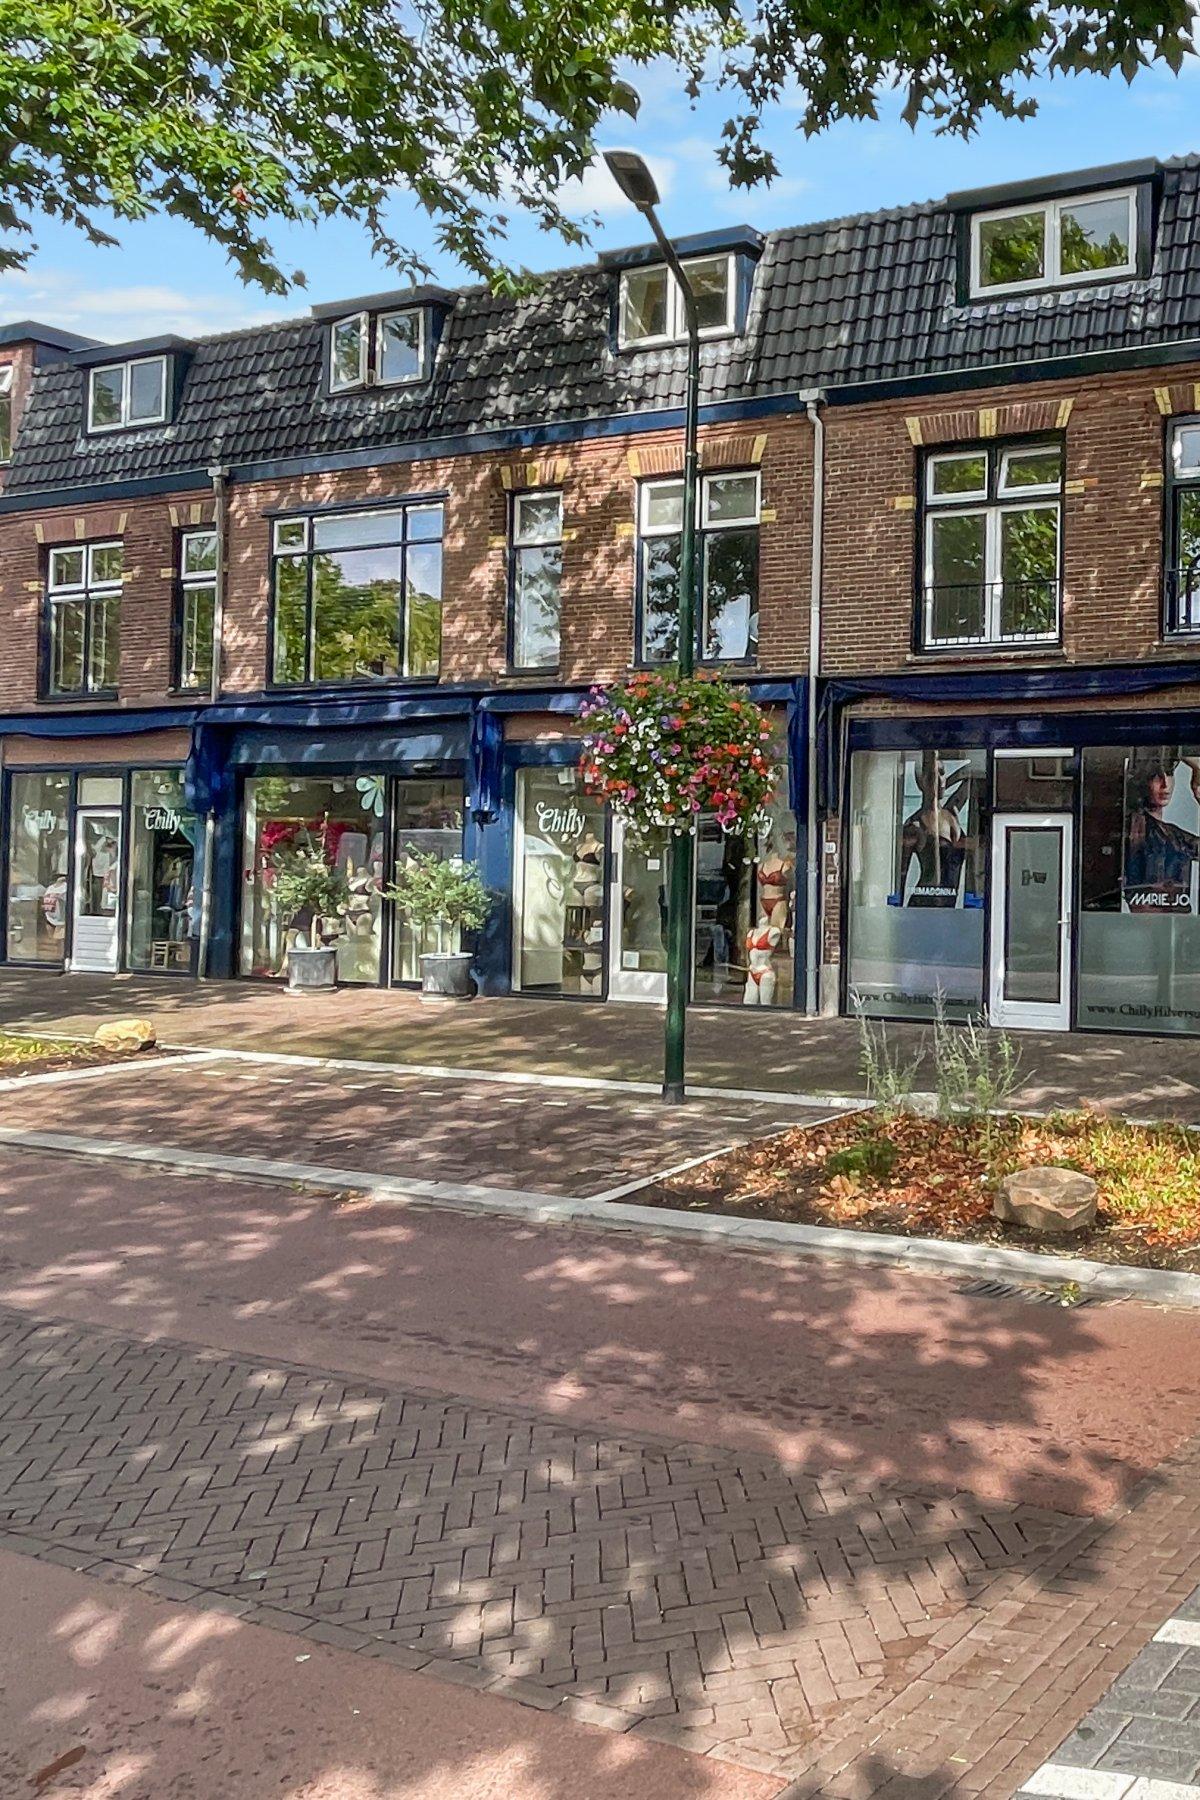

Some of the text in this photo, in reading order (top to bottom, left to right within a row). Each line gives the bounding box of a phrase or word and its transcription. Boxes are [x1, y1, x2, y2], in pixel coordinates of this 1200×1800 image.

[143, 803, 180, 835] Chilly
[536, 801, 586, 838] Chilly
[1129, 892, 1190, 906] MARIE JO
